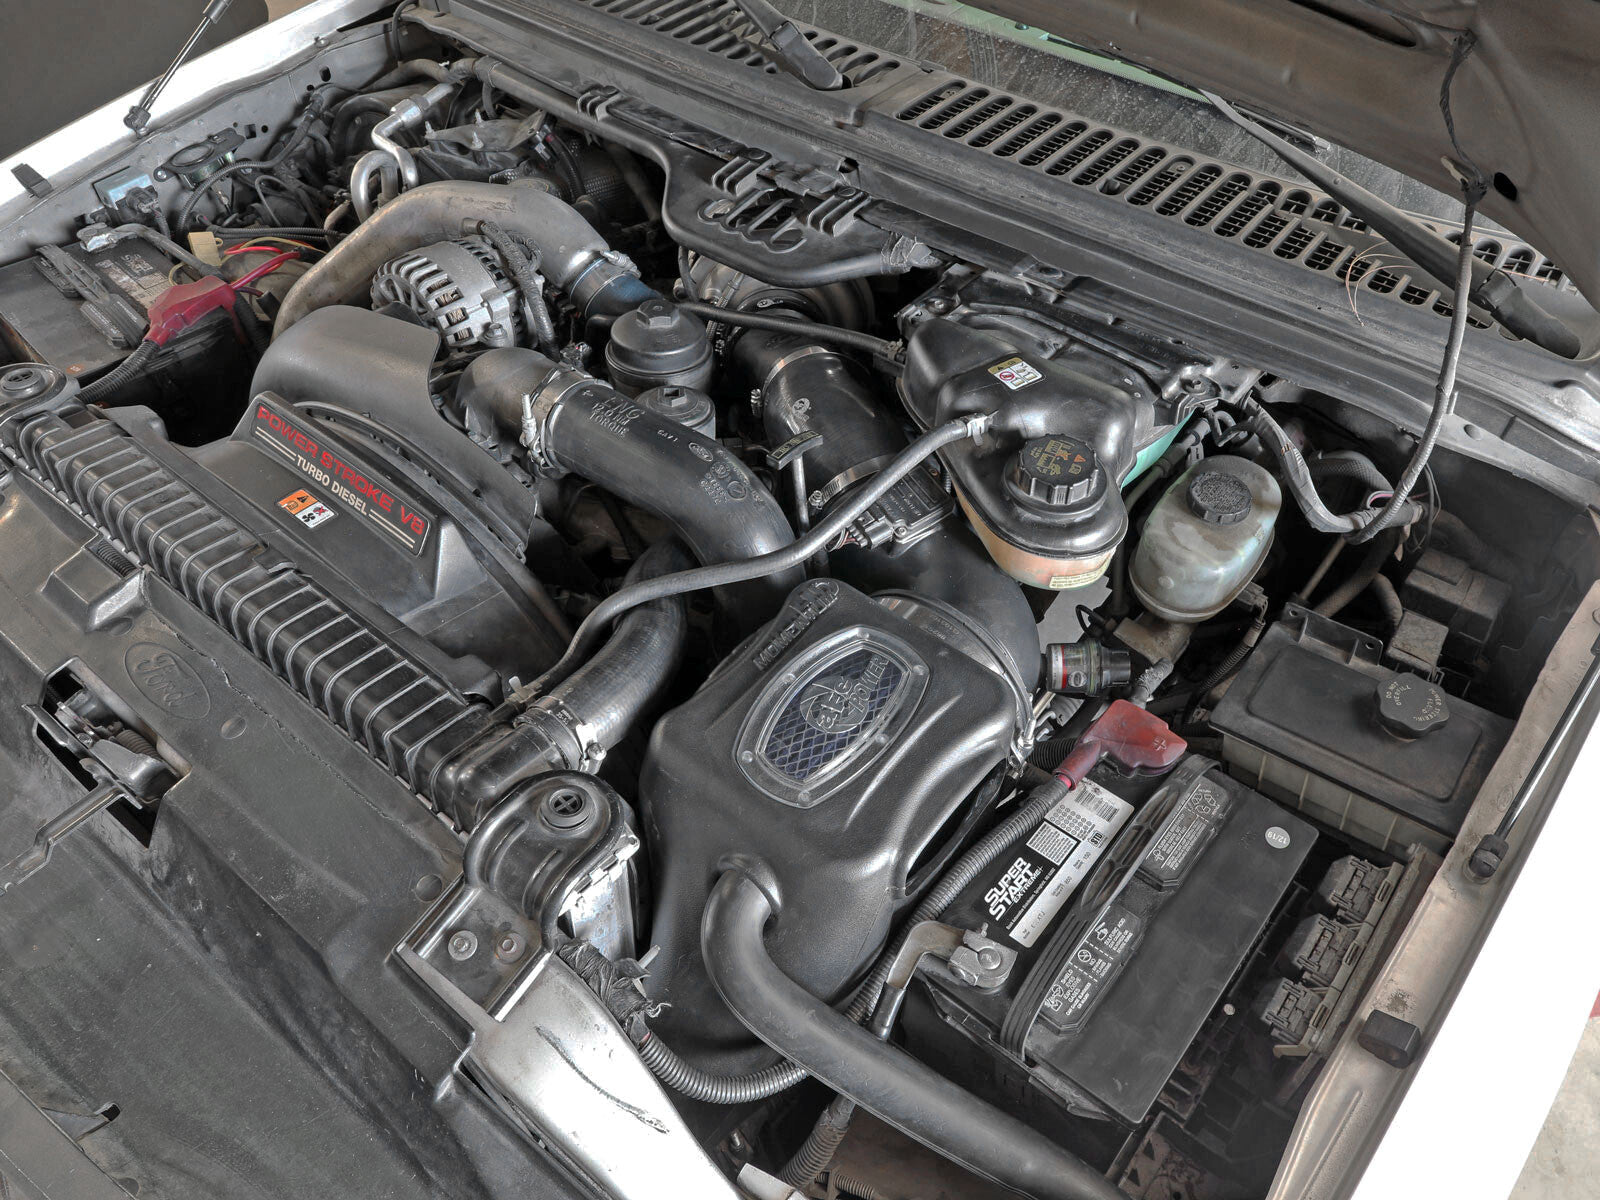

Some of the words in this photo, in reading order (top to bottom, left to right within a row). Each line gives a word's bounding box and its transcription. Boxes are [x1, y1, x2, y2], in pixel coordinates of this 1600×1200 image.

[589, 414, 628, 438] TORQUE
[257, 406, 318, 458] POWER
[320, 452, 394, 512] STROKE
[400, 505, 425, 535] V8
[295, 455, 329, 486] TURBO
[331, 481, 367, 516] DIESEL
[135, 653, 197, 706] Ford
[847, 654, 890, 714] POWER
[1386, 691, 1391, 699] DO
[1266, 831, 1287, 843] 12/19
[984, 857, 1027, 903] SUPER
[989, 862, 1033, 921] START
[1059, 968, 1073, 984] SHIELD
